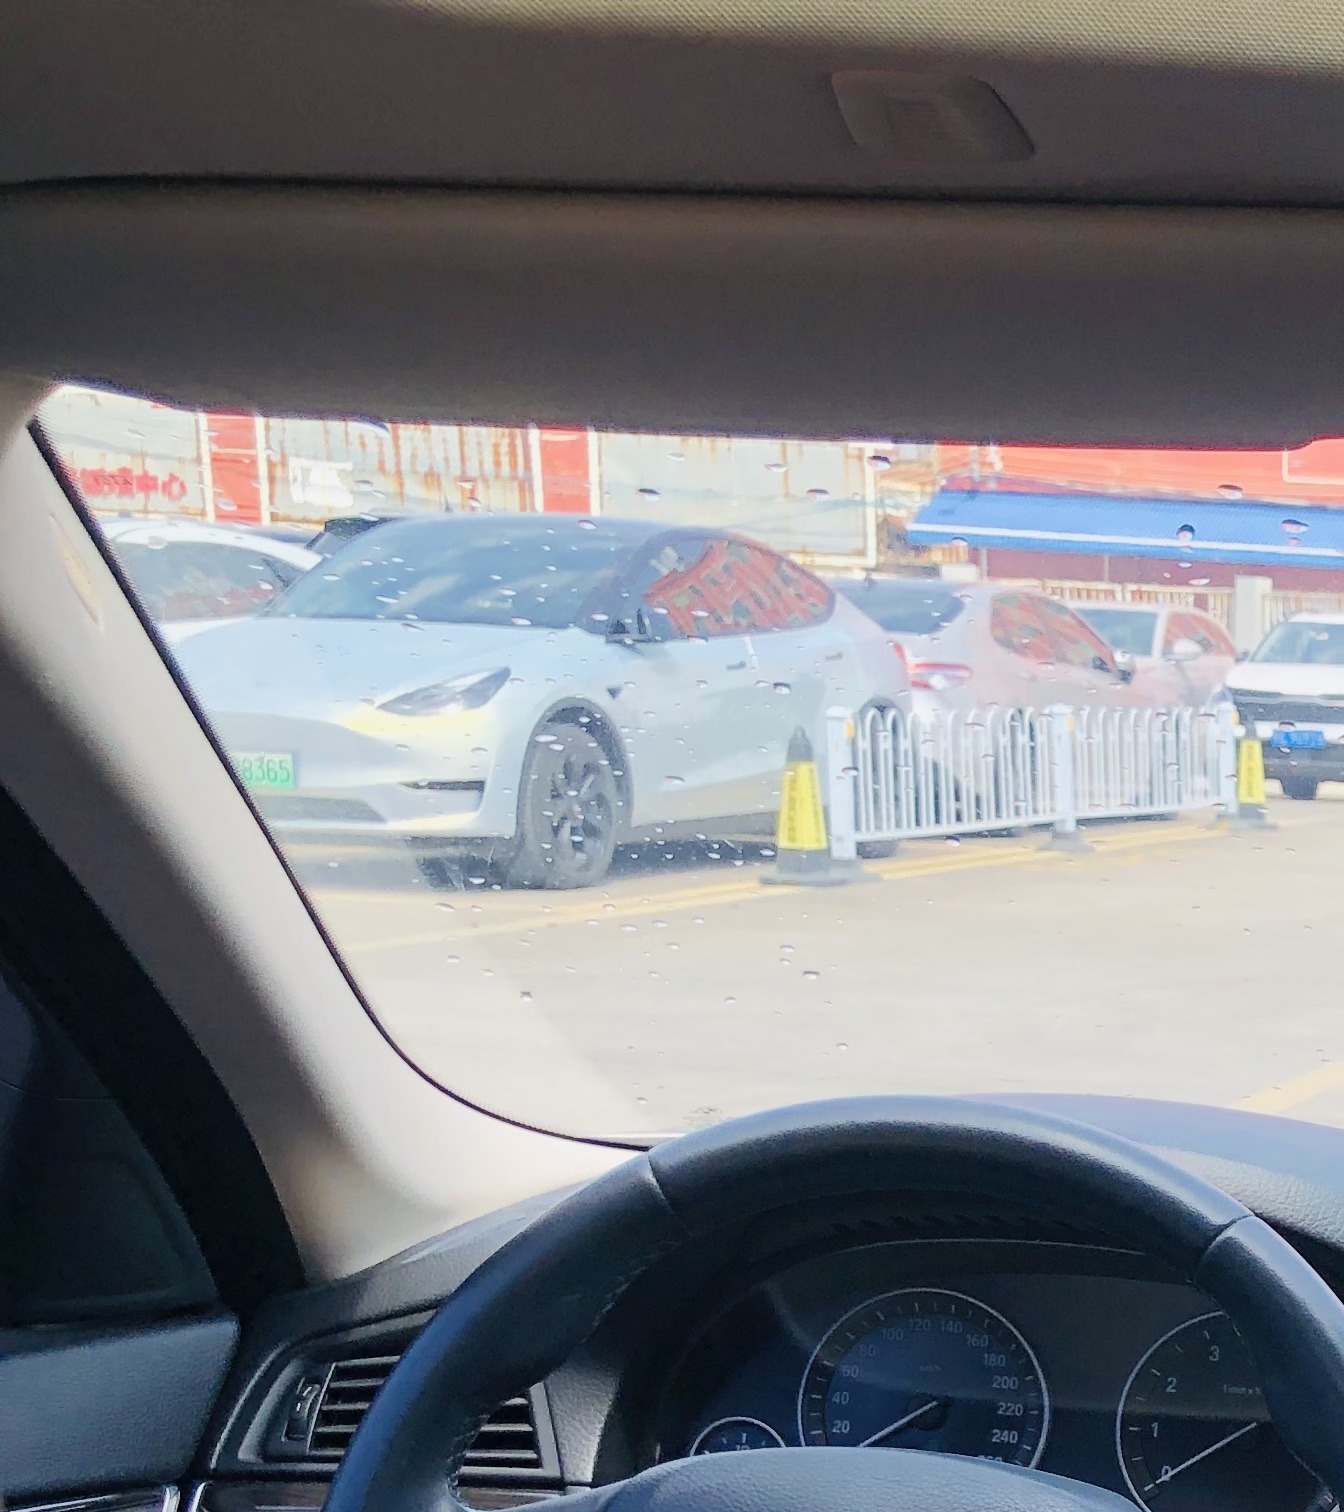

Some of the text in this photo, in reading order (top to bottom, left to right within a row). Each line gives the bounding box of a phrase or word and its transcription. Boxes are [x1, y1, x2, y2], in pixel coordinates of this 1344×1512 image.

[907, 1318, 931, 1332] 120
[940, 1320, 963, 1334] 140
[881, 1328, 904, 1342] 100
[966, 1334, 989, 1348] 160
[1209, 1345, 1220, 1361] 3
[983, 1353, 1006, 1368] 180
[842, 1365, 859, 1378] 60
[992, 1376, 1019, 1390] 200
[1165, 1377, 1177, 1393] 2
[832, 1391, 850, 1404] 40
[997, 1402, 1023, 1417] 220
[832, 1420, 850, 1434] 20
[1151, 1422, 1159, 1438] 1
[991, 1429, 1018, 1444] 240
